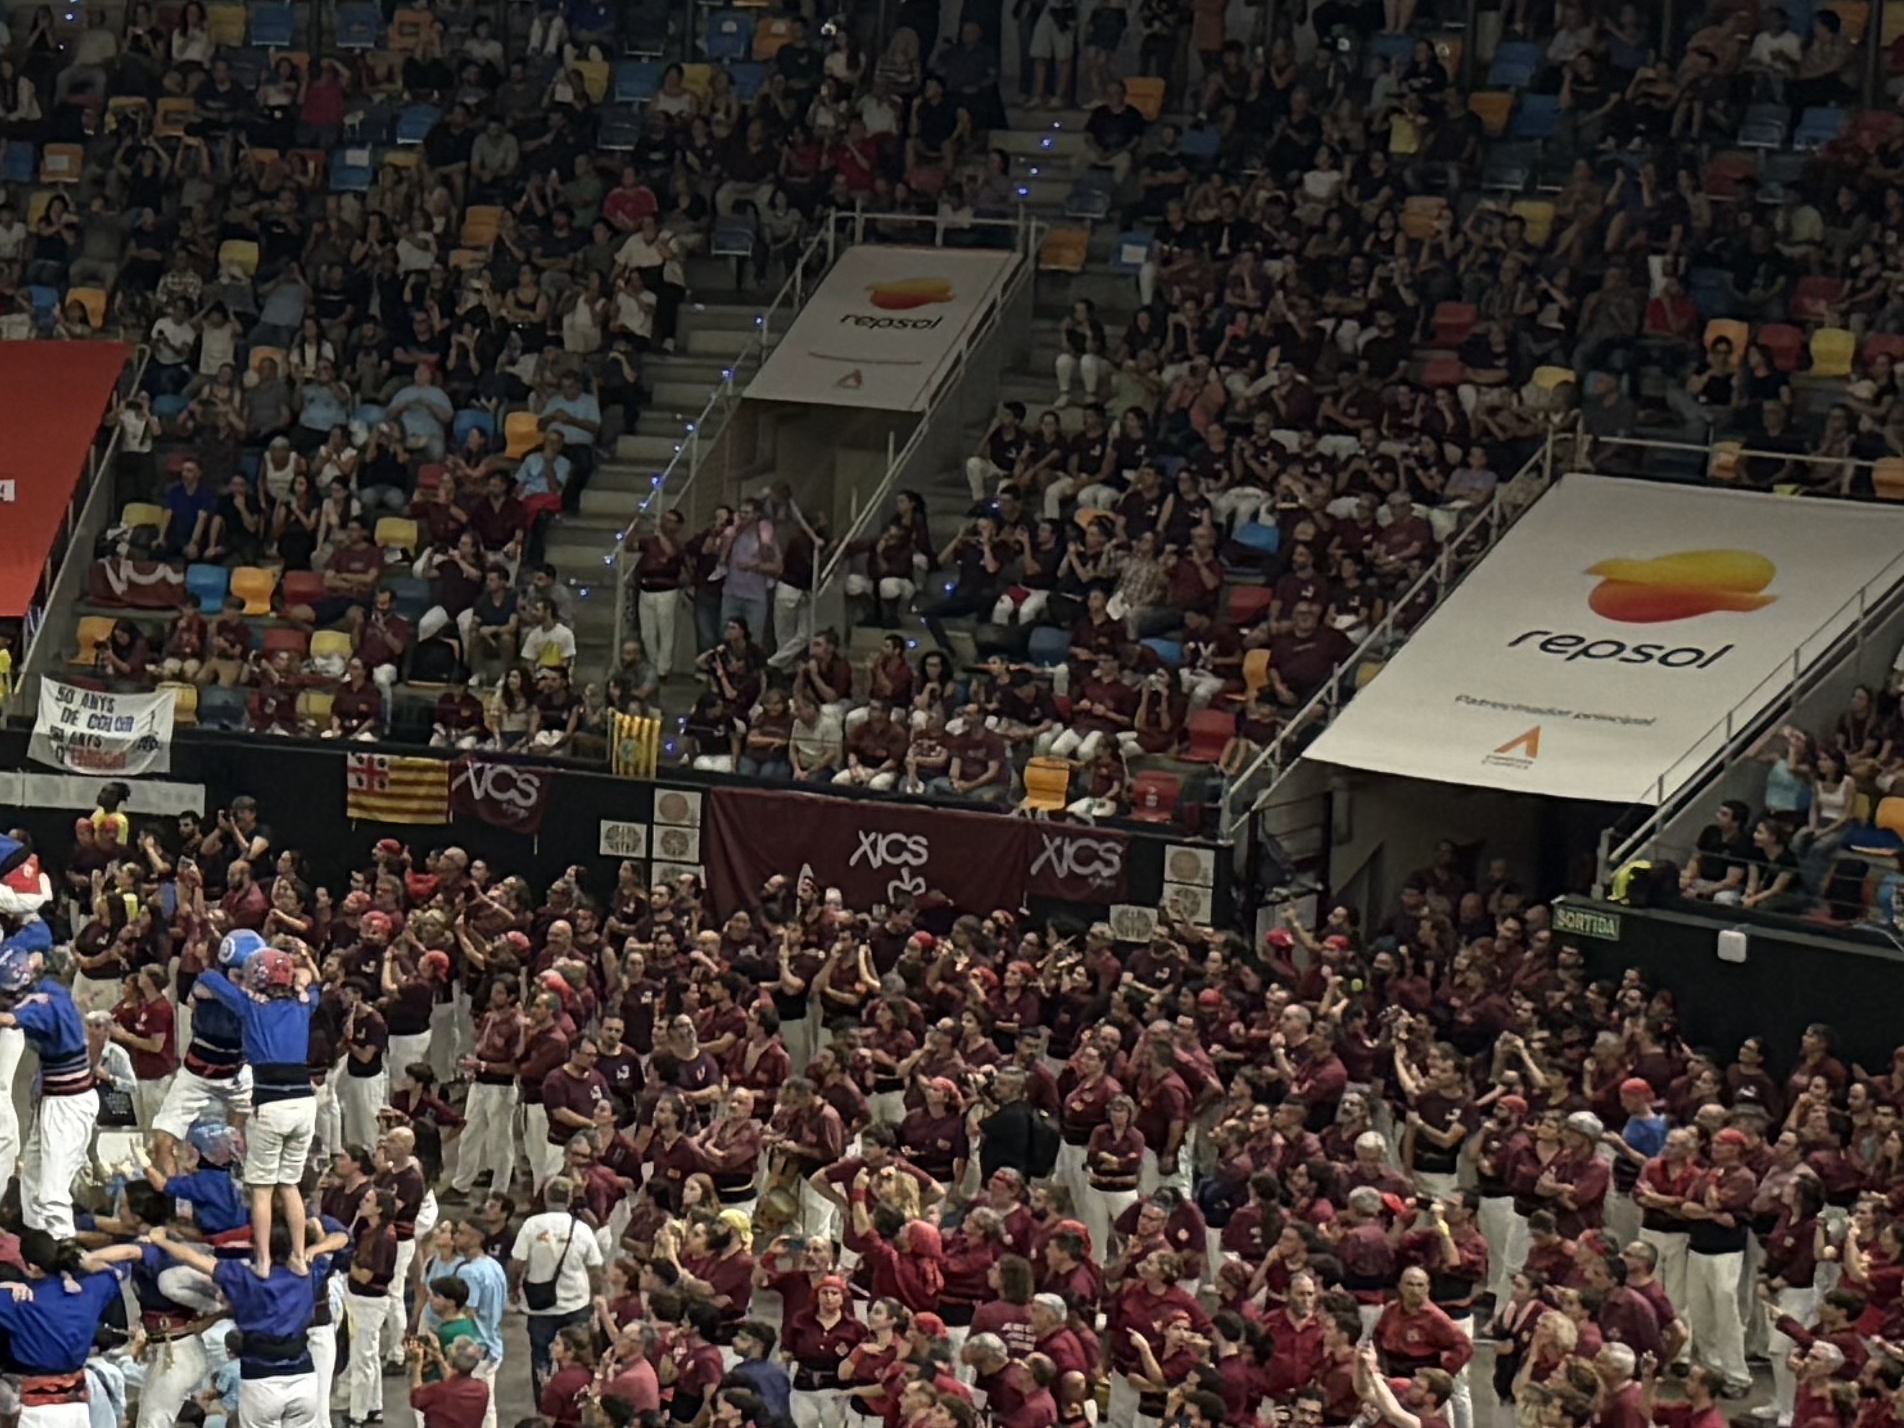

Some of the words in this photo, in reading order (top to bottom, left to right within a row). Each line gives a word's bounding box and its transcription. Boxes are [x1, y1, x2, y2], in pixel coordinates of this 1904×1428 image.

[839, 313, 944, 330] repsol
[1507, 626, 1735, 670] repsol
[80, 692, 116, 714] ANYS
[849, 829, 929, 870] XICS
